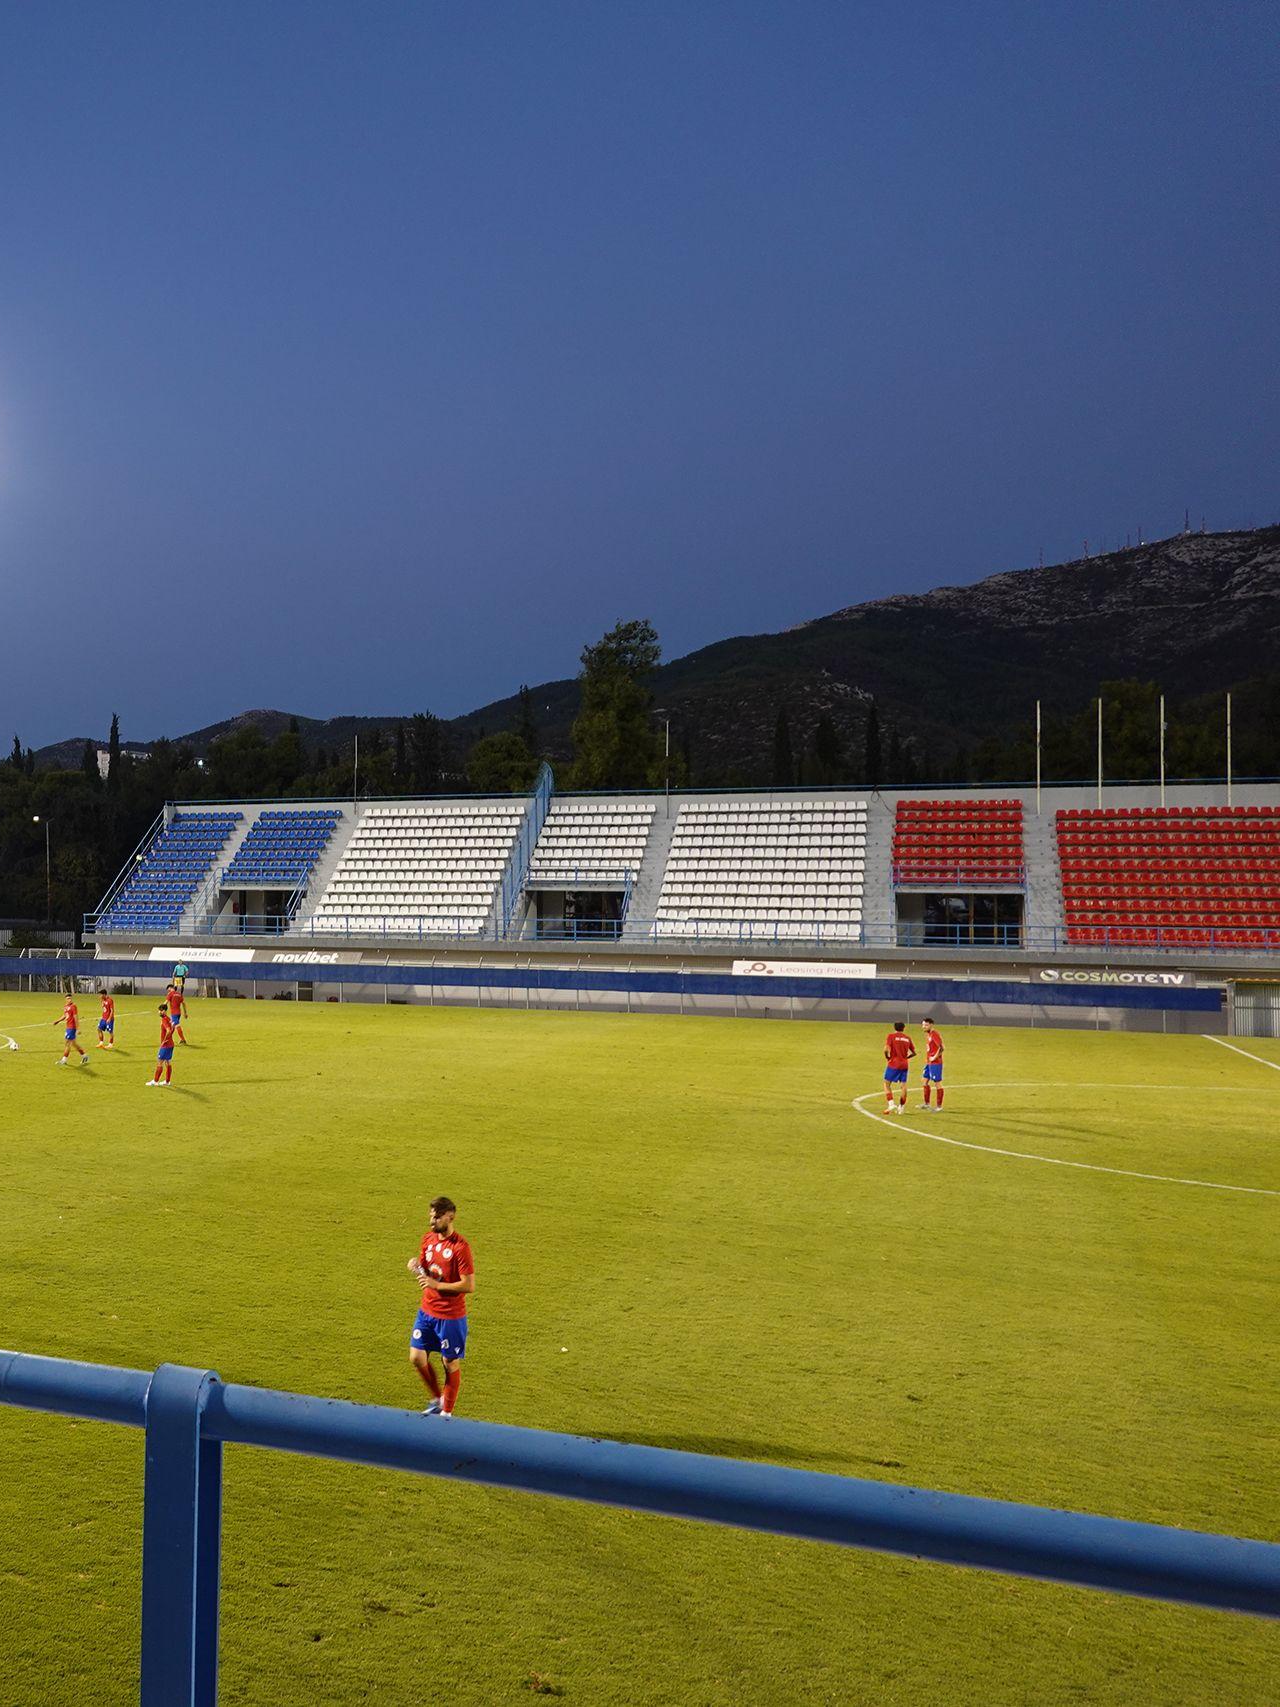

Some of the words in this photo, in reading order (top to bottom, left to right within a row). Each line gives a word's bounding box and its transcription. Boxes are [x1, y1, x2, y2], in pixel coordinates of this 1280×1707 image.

[181, 950, 223, 958] marine
[272, 951, 339, 963] novibet
[780, 967, 824, 976] Leasing
[826, 967, 863, 975] Planet
